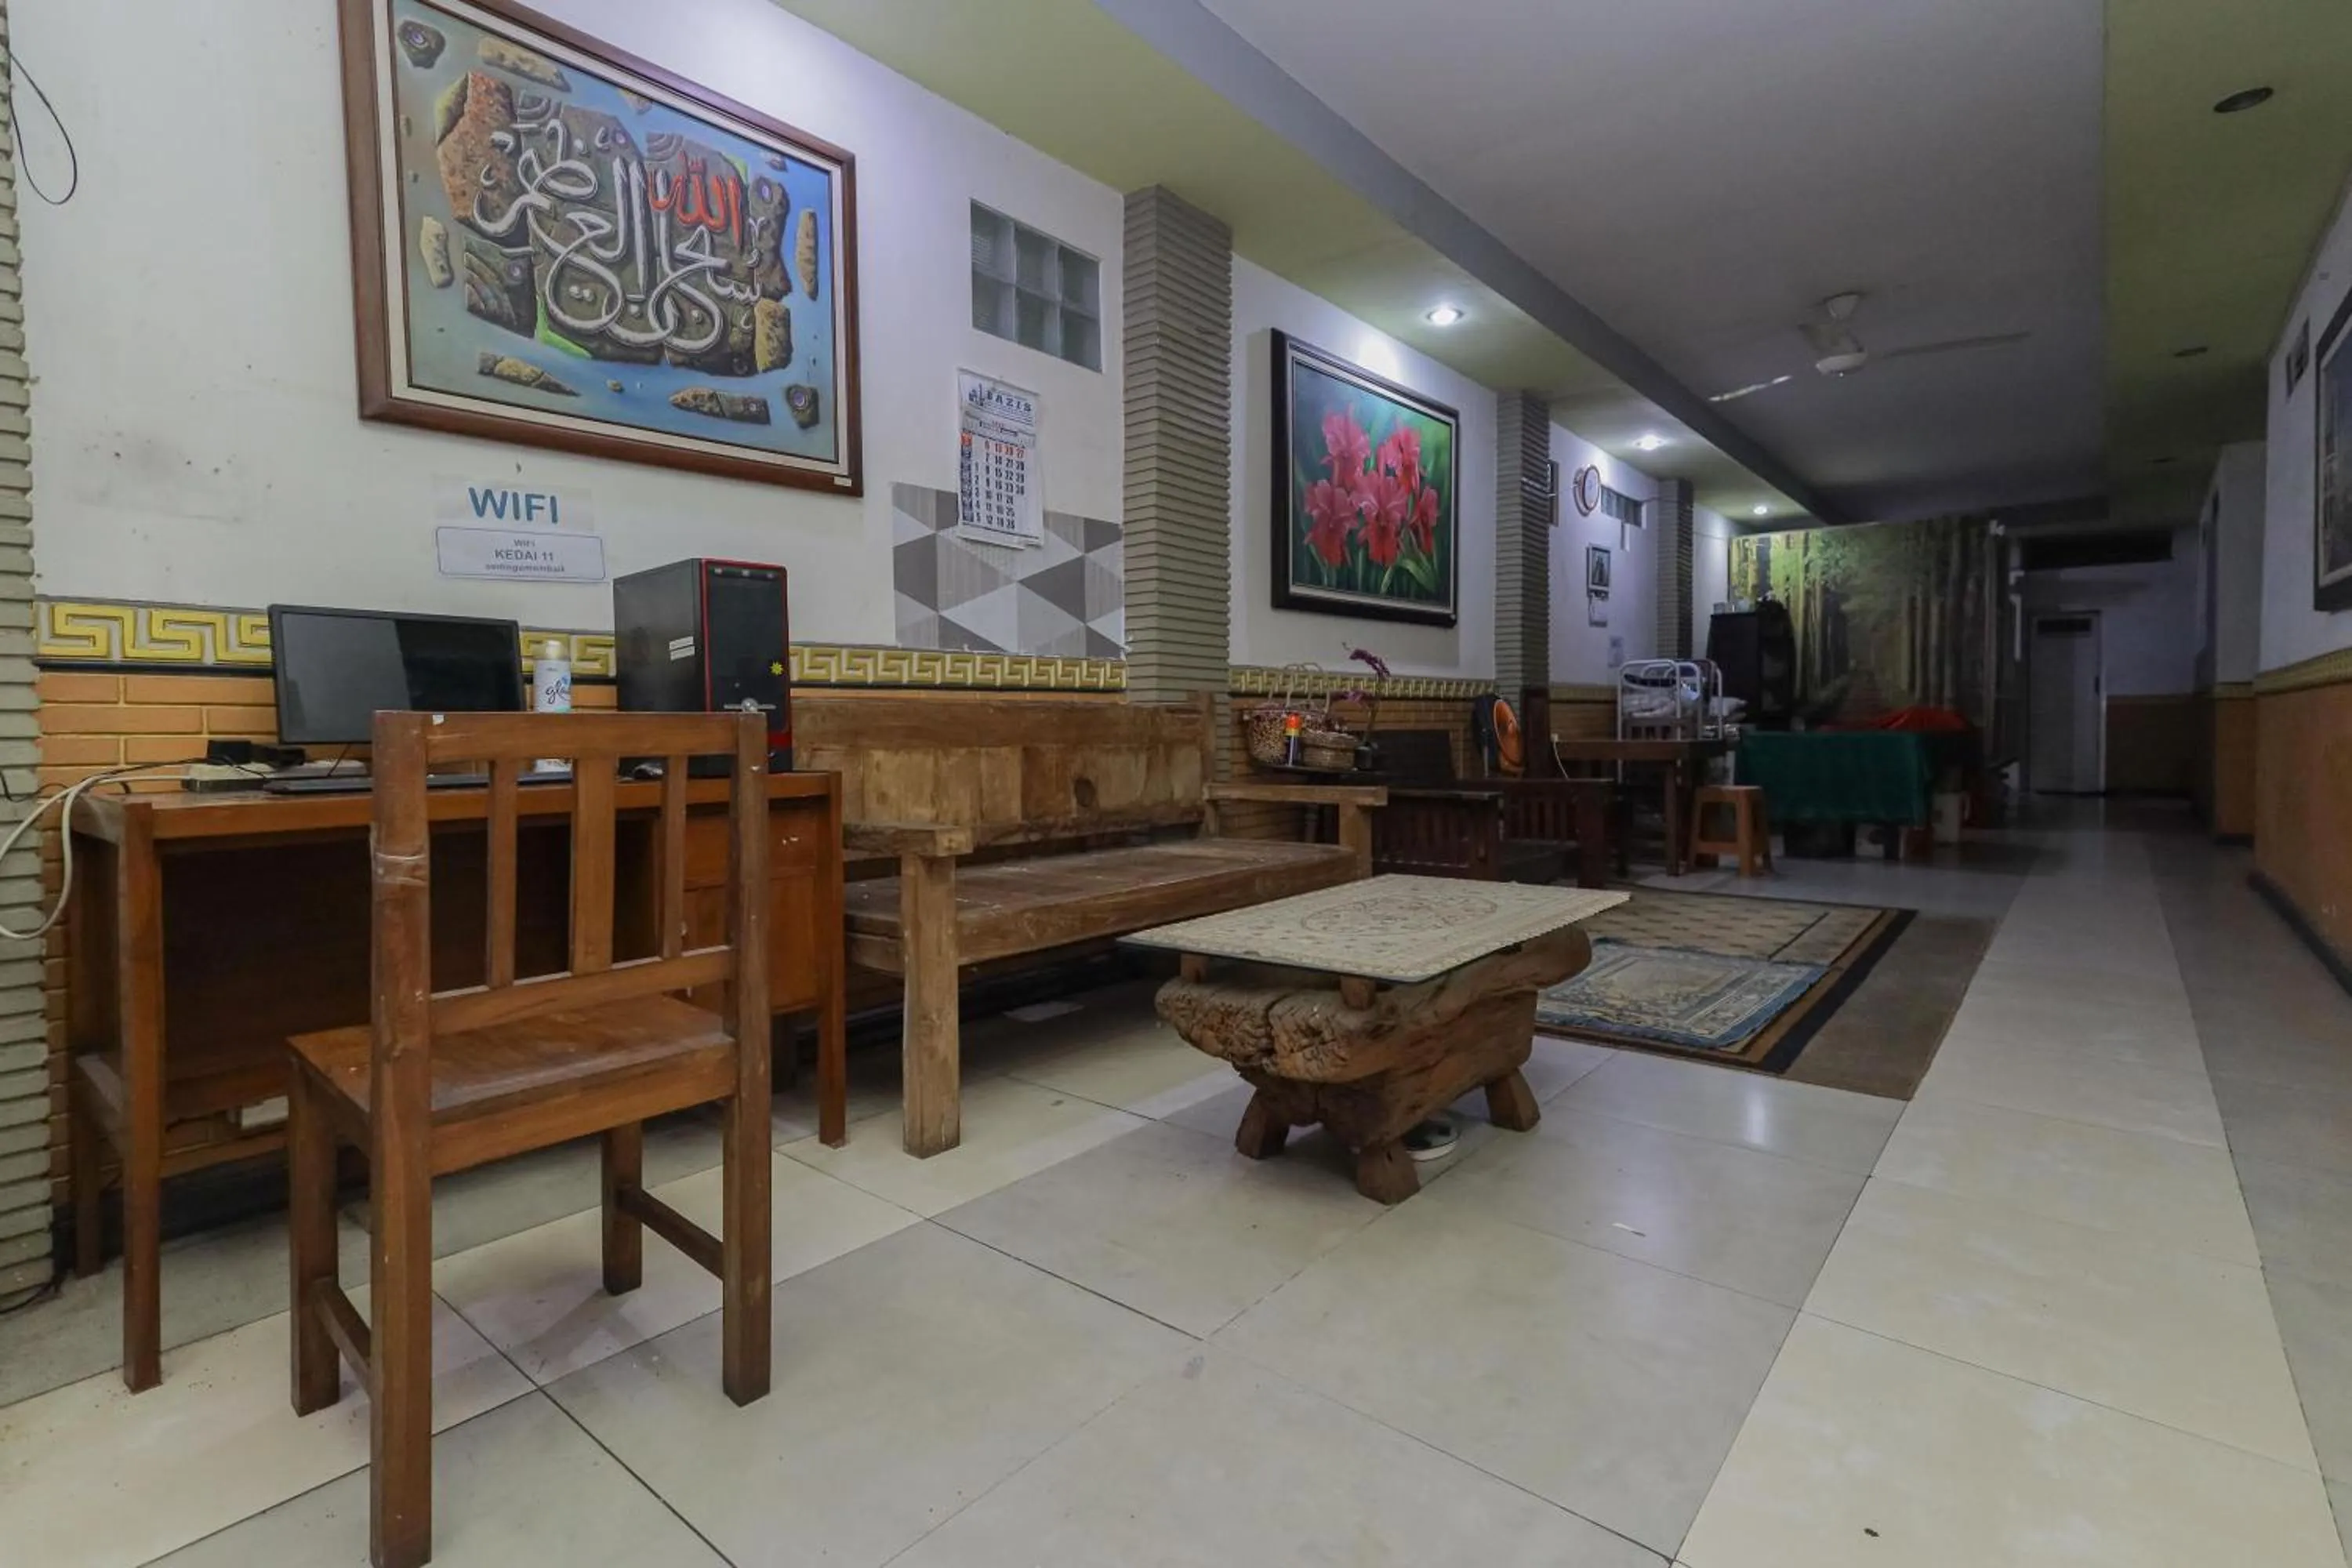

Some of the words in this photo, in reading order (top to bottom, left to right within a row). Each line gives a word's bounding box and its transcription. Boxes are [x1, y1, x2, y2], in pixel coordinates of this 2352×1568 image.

[468, 486, 559, 524] WIFI
[494, 548, 538, 561] KEDAI
[542, 551, 554, 561] 11
